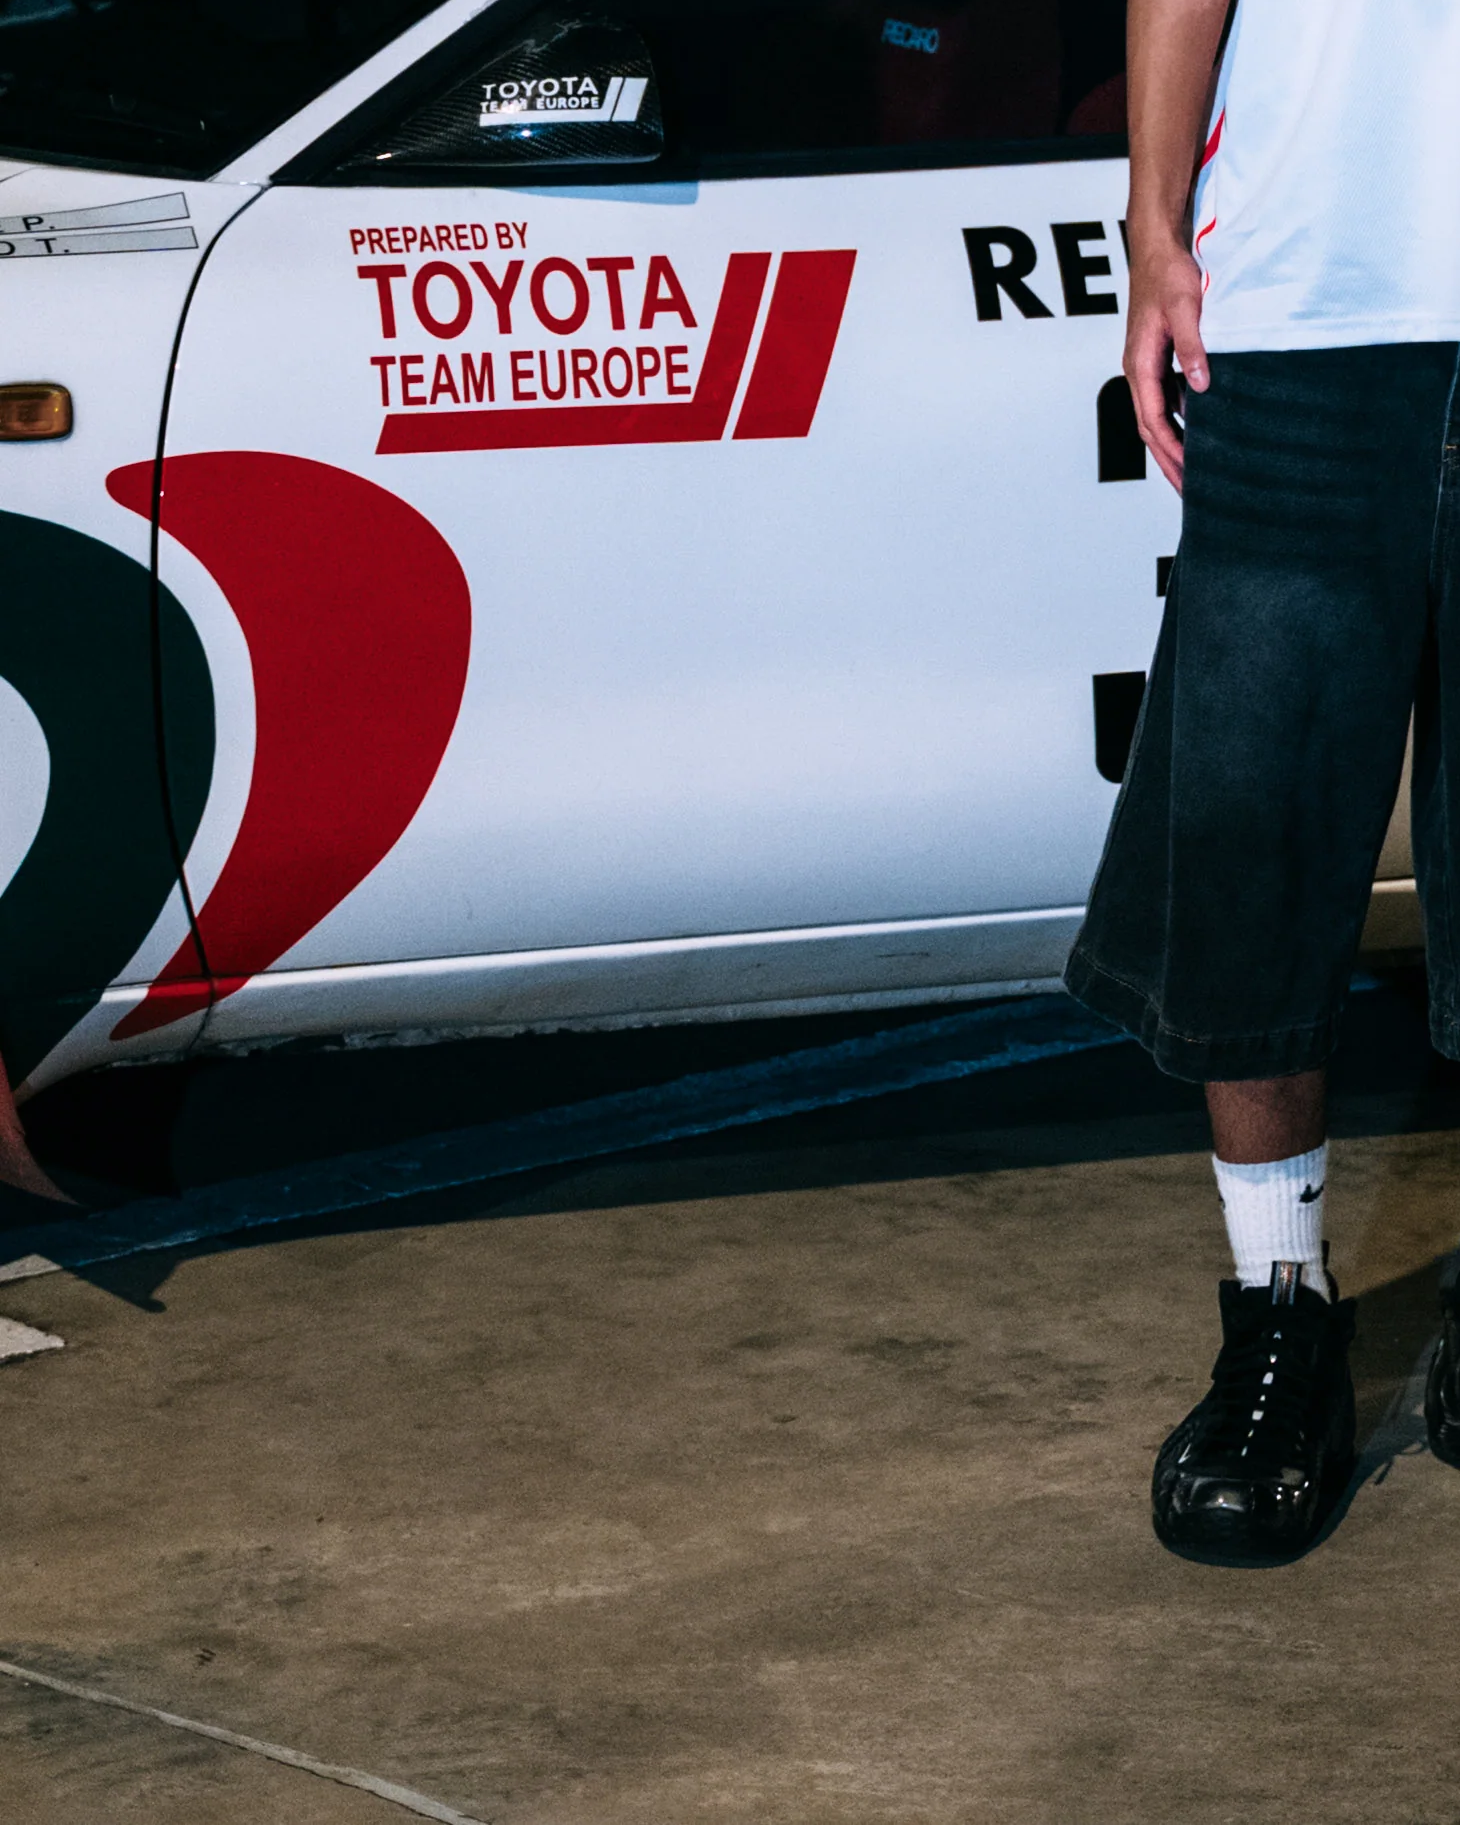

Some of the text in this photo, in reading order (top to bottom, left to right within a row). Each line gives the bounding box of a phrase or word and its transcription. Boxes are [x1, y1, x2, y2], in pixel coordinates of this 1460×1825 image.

[480, 96, 599, 114] TEAM EUROPE
[482, 76, 599, 100] TOYOTA
[349, 221, 529, 256] PREPARED BY
[961, 220, 1130, 322] RE
[357, 255, 698, 340] TOYOTA
[370, 345, 692, 407] TEAM EUROPE
